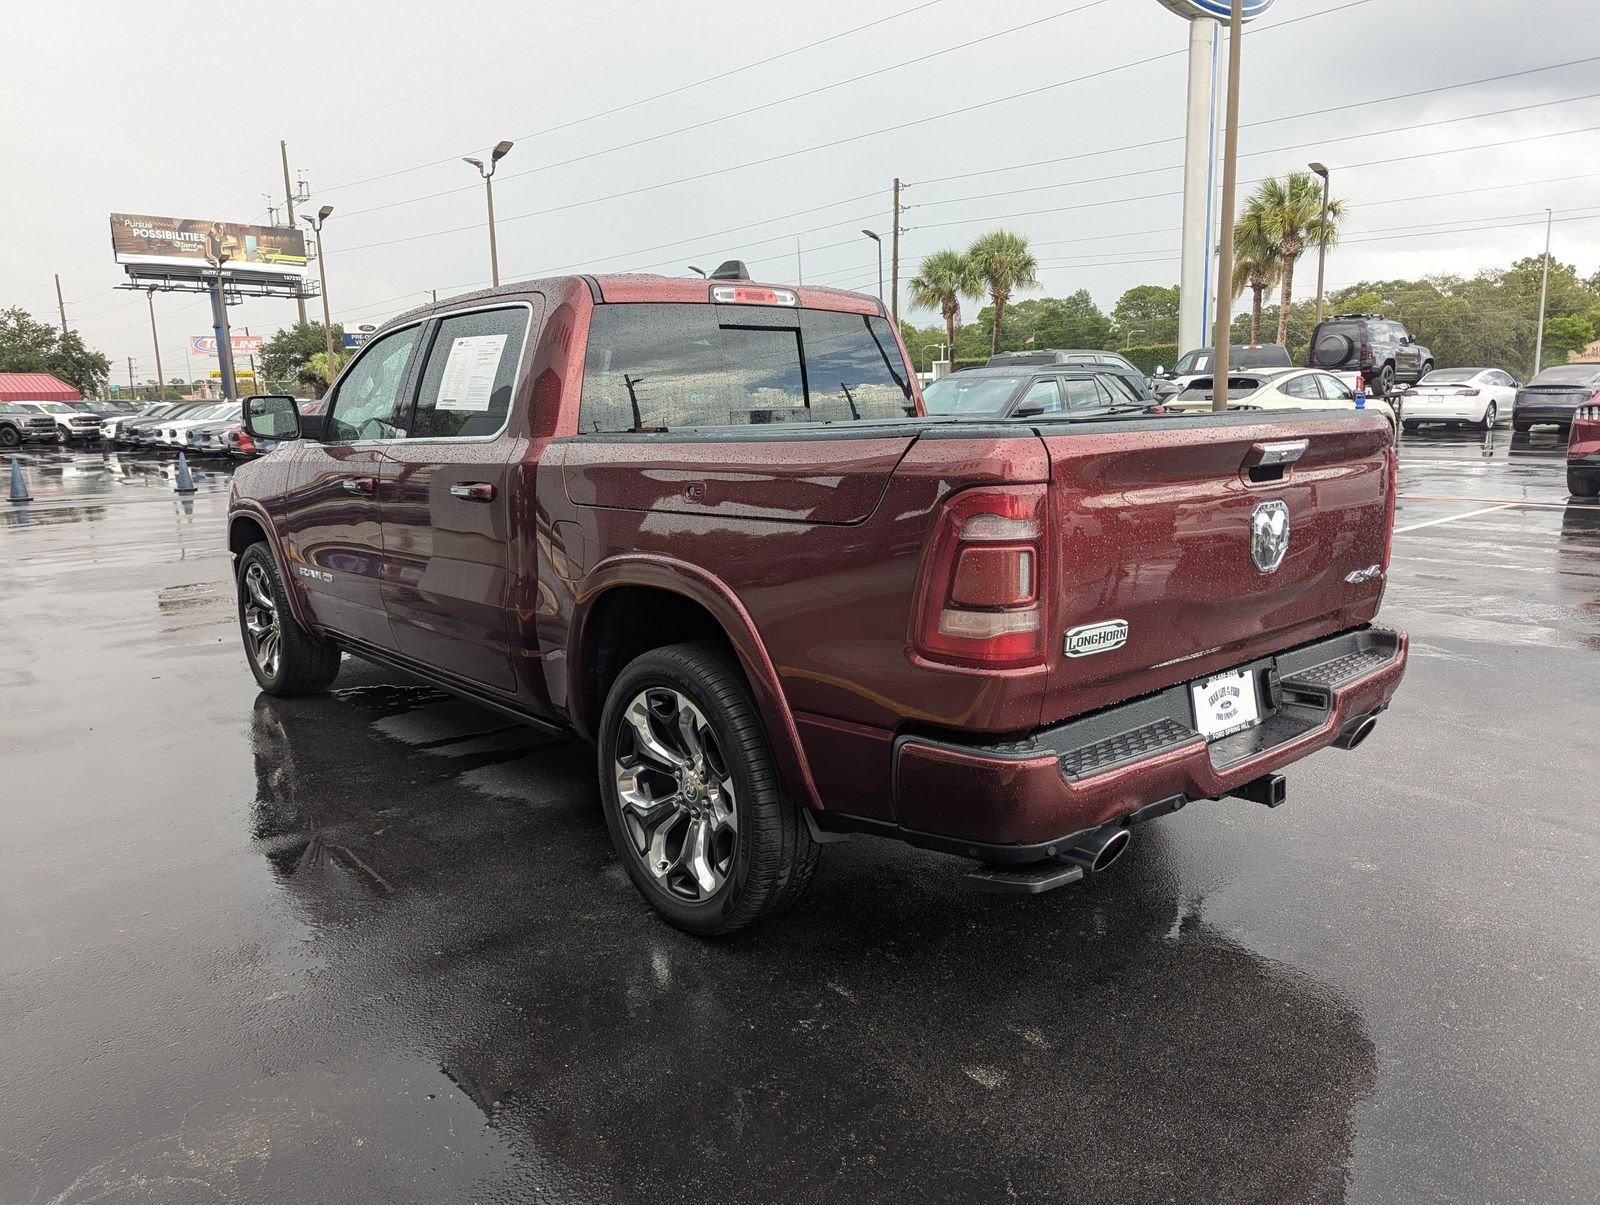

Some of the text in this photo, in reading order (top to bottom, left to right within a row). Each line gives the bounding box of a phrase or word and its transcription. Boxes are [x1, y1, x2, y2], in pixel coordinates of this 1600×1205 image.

[124, 219, 153, 229] Pursue
[132, 228, 206, 242] POSSIBILITIES
[1261, 502, 1283, 510] RAM
[1067, 628, 1127, 650] LONGHORN
[1212, 730, 1225, 740] FORD
[1224, 724, 1241, 736] SPRING
